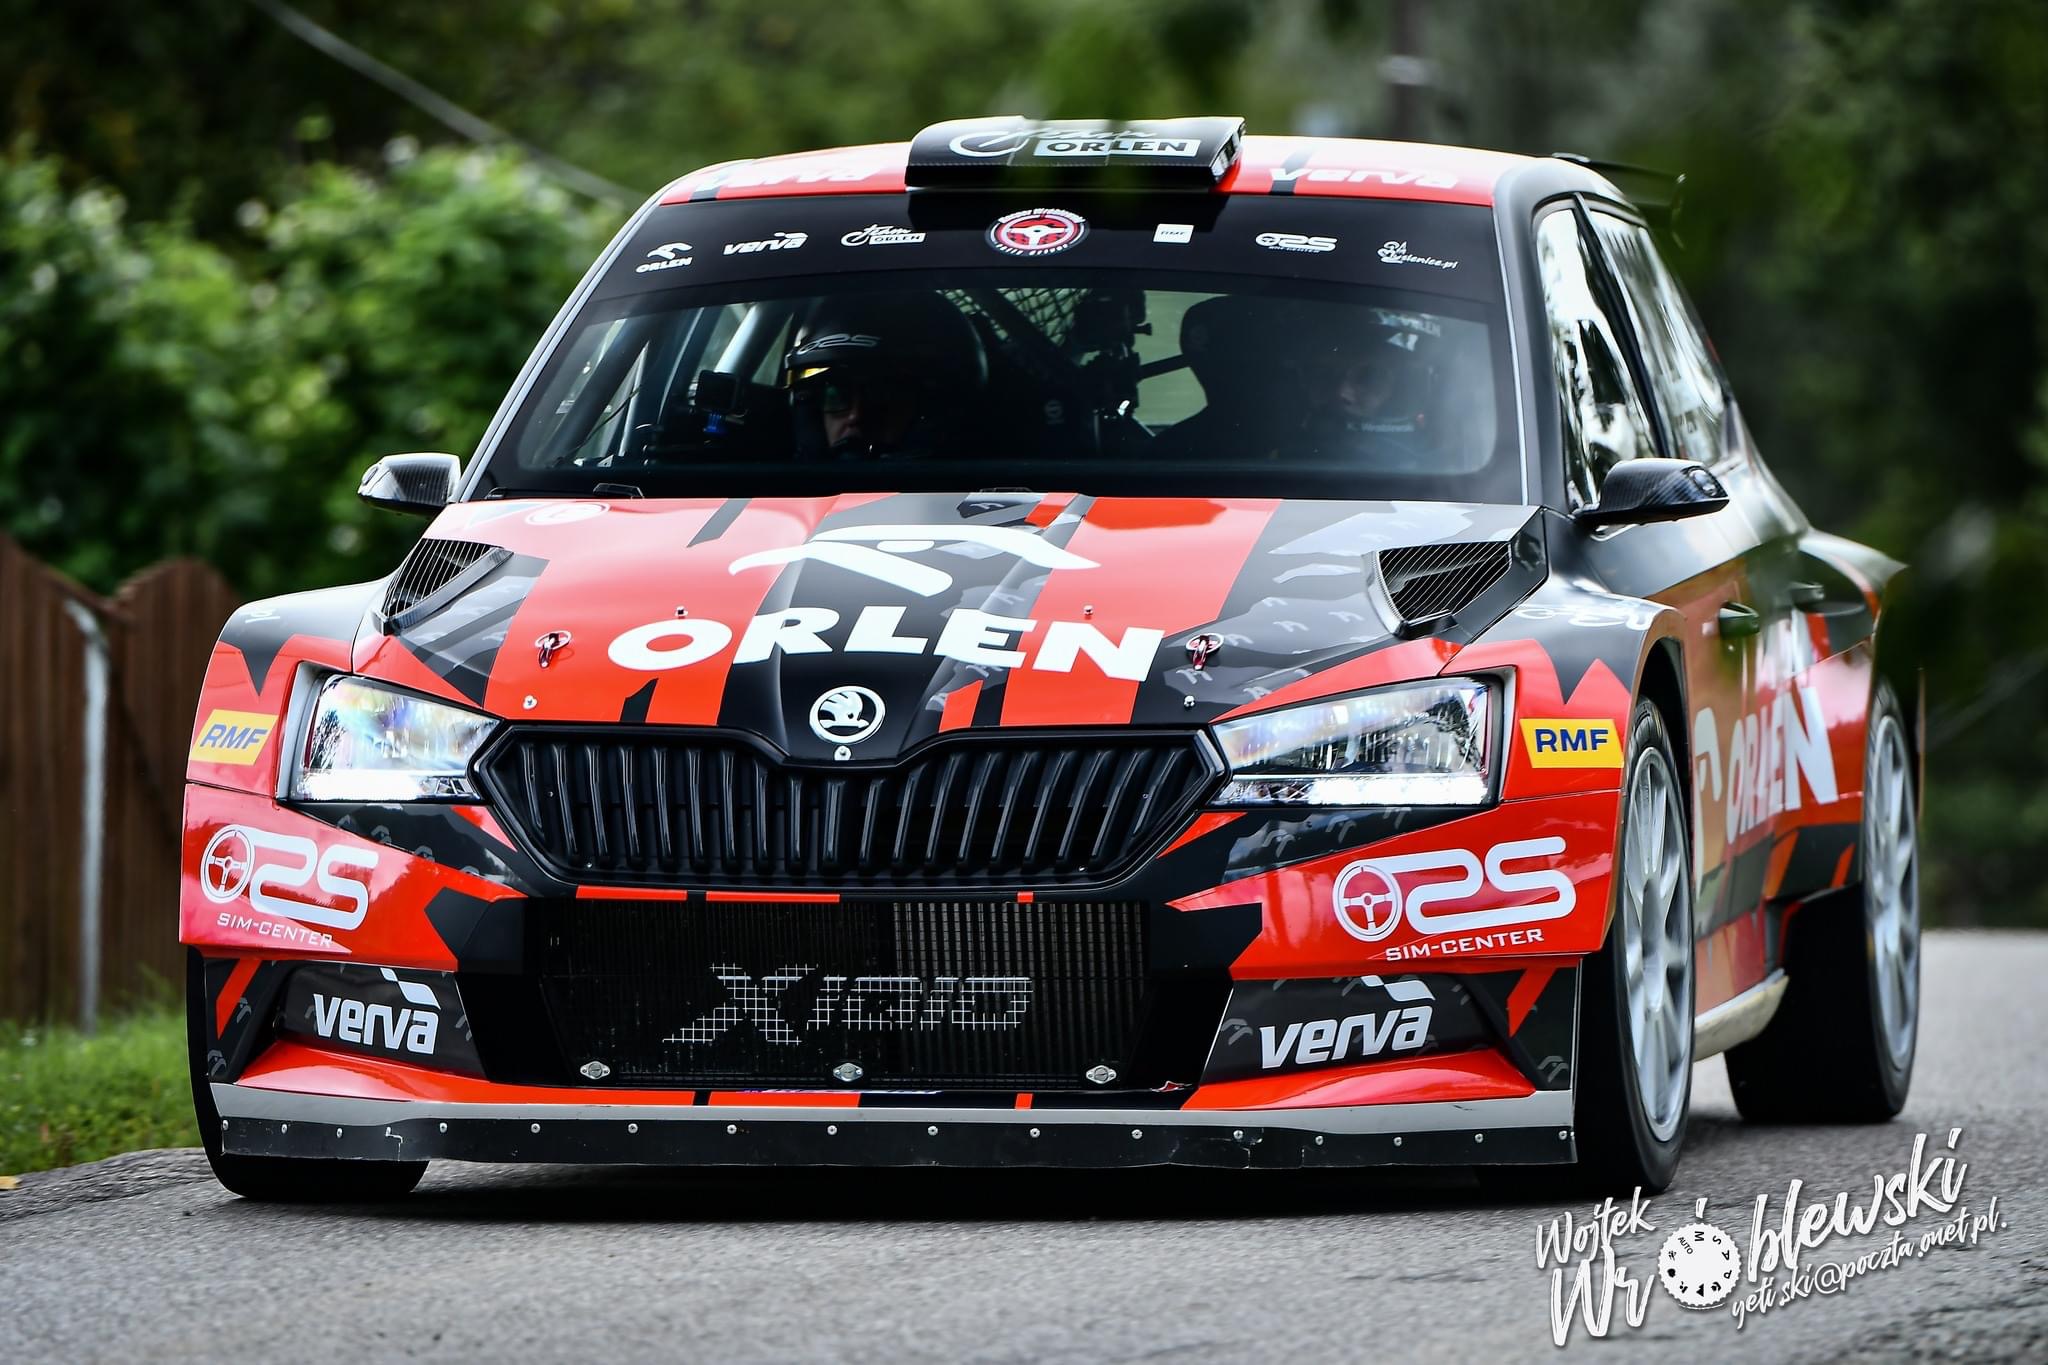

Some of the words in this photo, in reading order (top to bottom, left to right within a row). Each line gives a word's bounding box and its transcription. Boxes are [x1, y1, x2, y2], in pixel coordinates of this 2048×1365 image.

[1046, 141, 1187, 152] ORLEN
[1270, 166, 1459, 189] verva
[723, 237, 809, 256] verva
[636, 257, 693, 273] ORLEN
[607, 606, 1166, 683] ORLEN
[200, 724, 269, 750] RMF
[1535, 728, 1609, 752] RMF
[1726, 686, 1840, 844] ORLEN
[217, 911, 333, 948] SIM-CENTER
[1385, 928, 1544, 962] SIM-CENTER
[313, 993, 439, 1055] verva
[1259, 1003, 1434, 1069] verva
